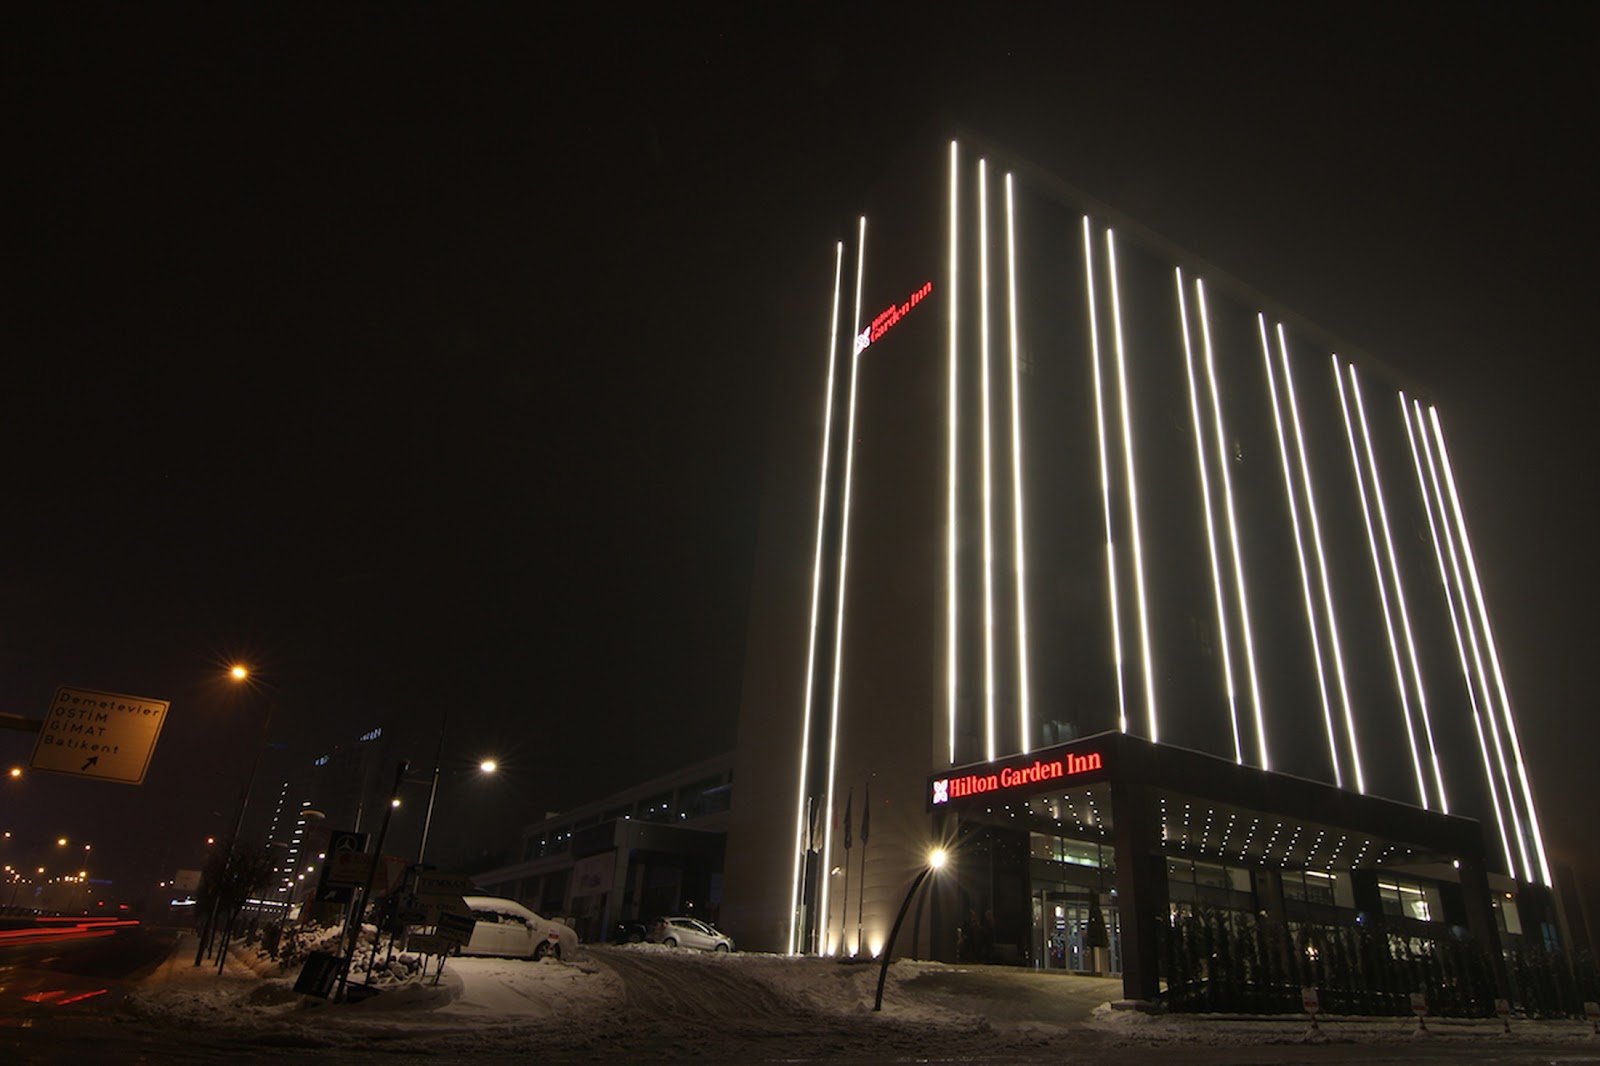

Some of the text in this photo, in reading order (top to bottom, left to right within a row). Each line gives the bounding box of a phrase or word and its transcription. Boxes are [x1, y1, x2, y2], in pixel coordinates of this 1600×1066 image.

[870, 281, 932, 343] Garden Inn
[60, 692, 160, 717] Demetevler
[949, 752, 1103, 798] Hilton Garden Inn
